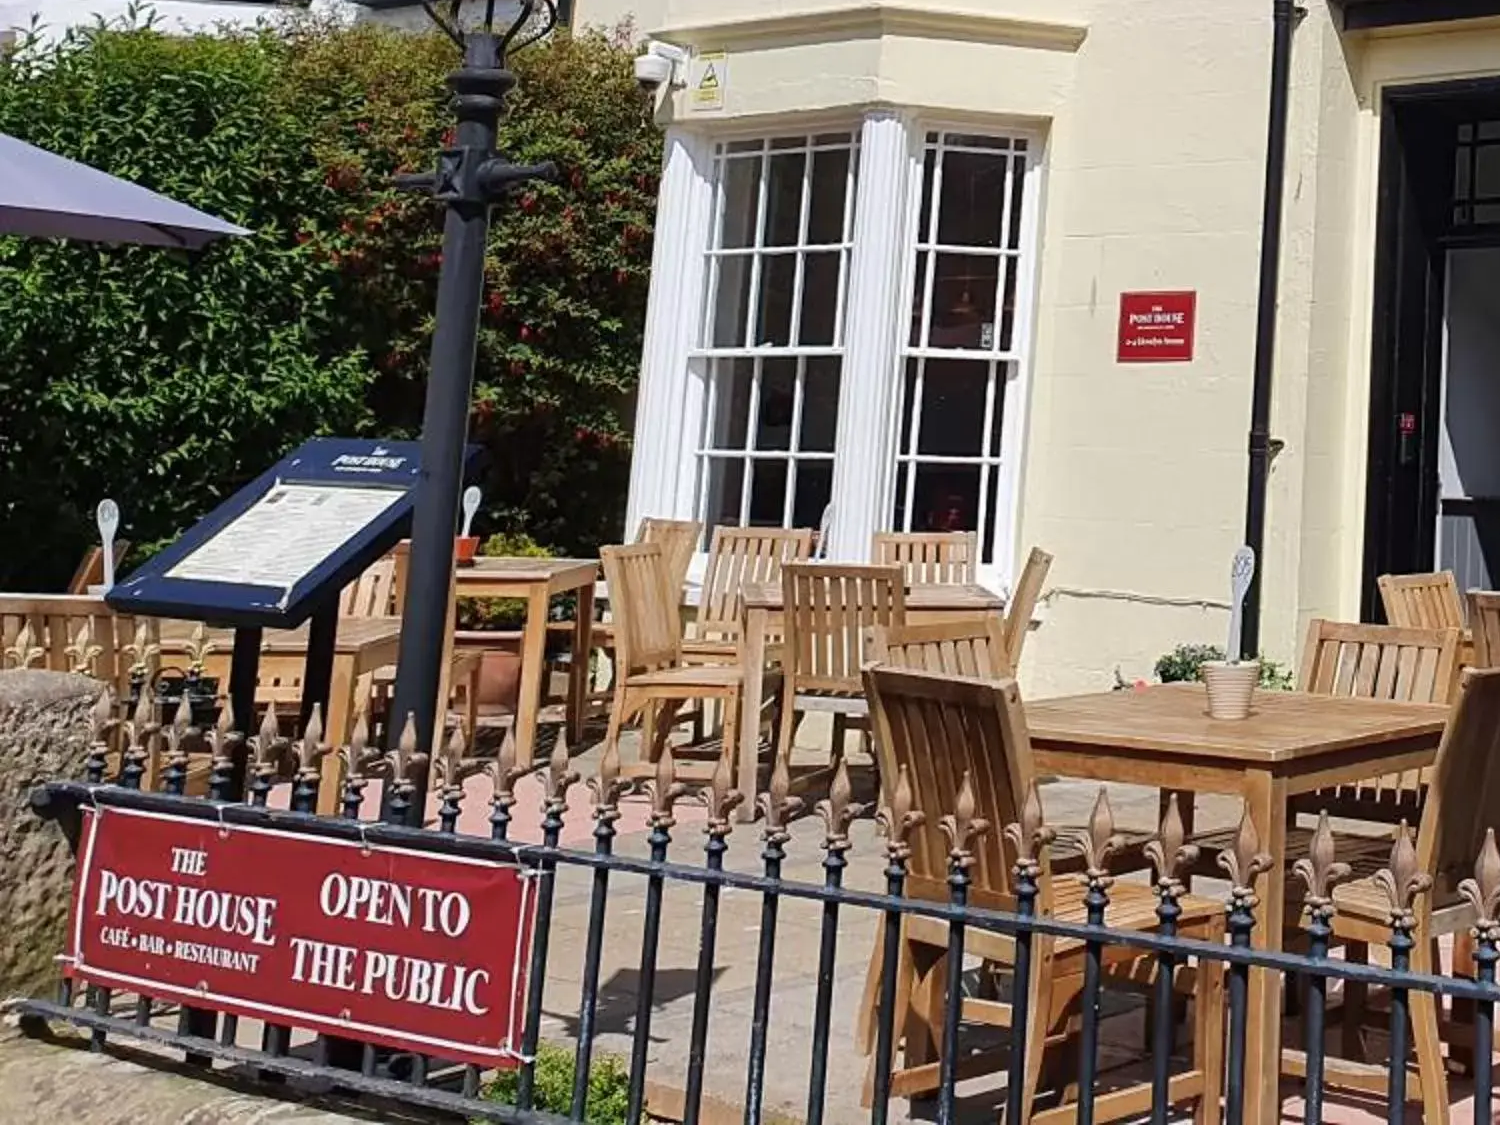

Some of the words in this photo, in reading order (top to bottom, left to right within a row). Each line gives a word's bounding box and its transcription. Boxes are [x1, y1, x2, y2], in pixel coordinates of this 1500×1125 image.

[171, 846, 208, 877] THE
[96, 870, 175, 920] POST
[174, 886, 278, 947] HOUSE
[320, 872, 414, 927] OPEN
[417, 890, 471, 938] TO
[101, 926, 132, 950] CAFÉ
[139, 932, 166, 955] BAR
[174, 939, 261, 974] RESTAURANT
[290, 937, 357, 991] THE
[362, 952, 491, 1017] PUBLIC
